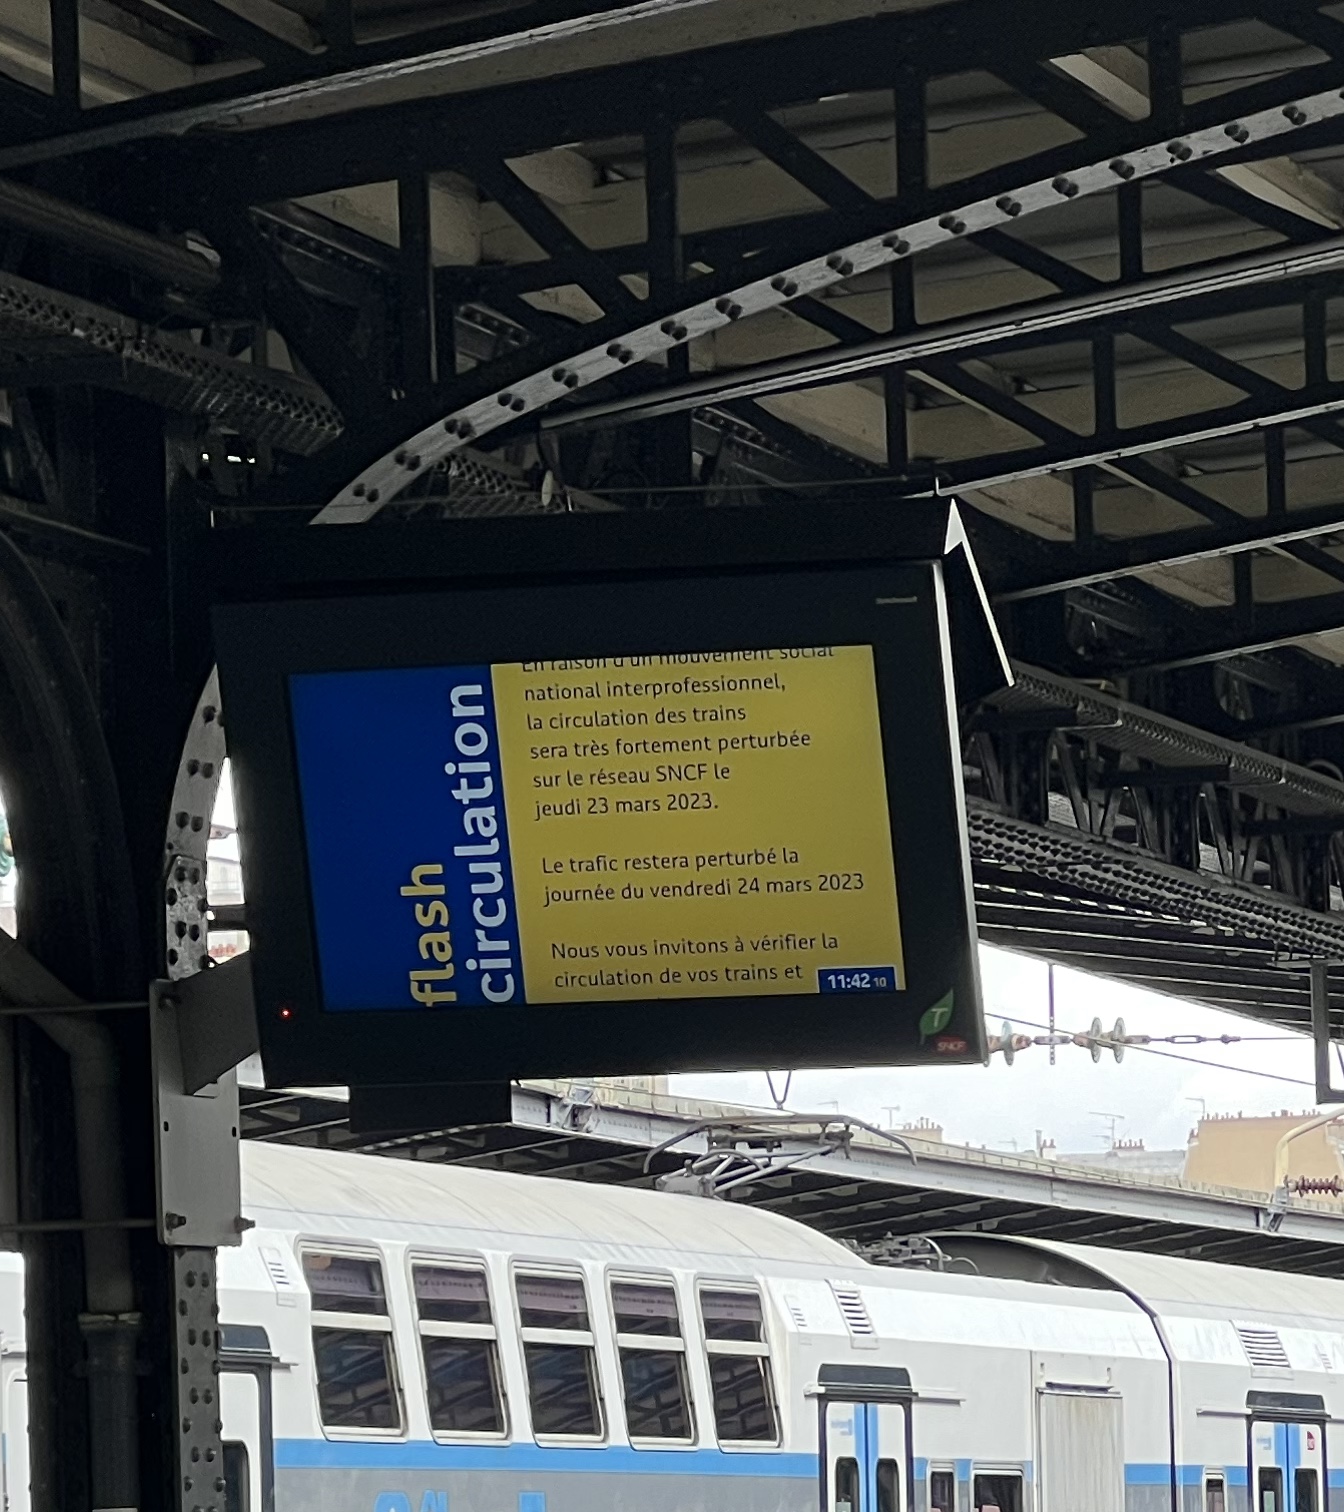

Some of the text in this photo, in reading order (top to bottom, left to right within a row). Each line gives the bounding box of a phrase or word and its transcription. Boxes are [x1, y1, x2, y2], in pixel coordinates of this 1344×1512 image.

[524, 672, 786, 702] national interprofessionnel,
[526, 704, 747, 731] la circulation des trains
[530, 729, 811, 760] sera très fortement perturbée
[533, 762, 730, 788] sur le réseau SNCF le
[534, 792, 719, 822] jeudi 23 mars 2023.
[445, 684, 516, 1004] circulation
[542, 847, 799, 874] Le trafic restera perturbé la
[543, 872, 864, 908] journée du vendredi 24 mars 2023
[400, 864, 457, 1007] flash
[551, 932, 838, 960] Nous vous invitons à vérifier la
[554, 963, 804, 988] circulation de vos trains et
[827, 972, 871, 989] 11:42
